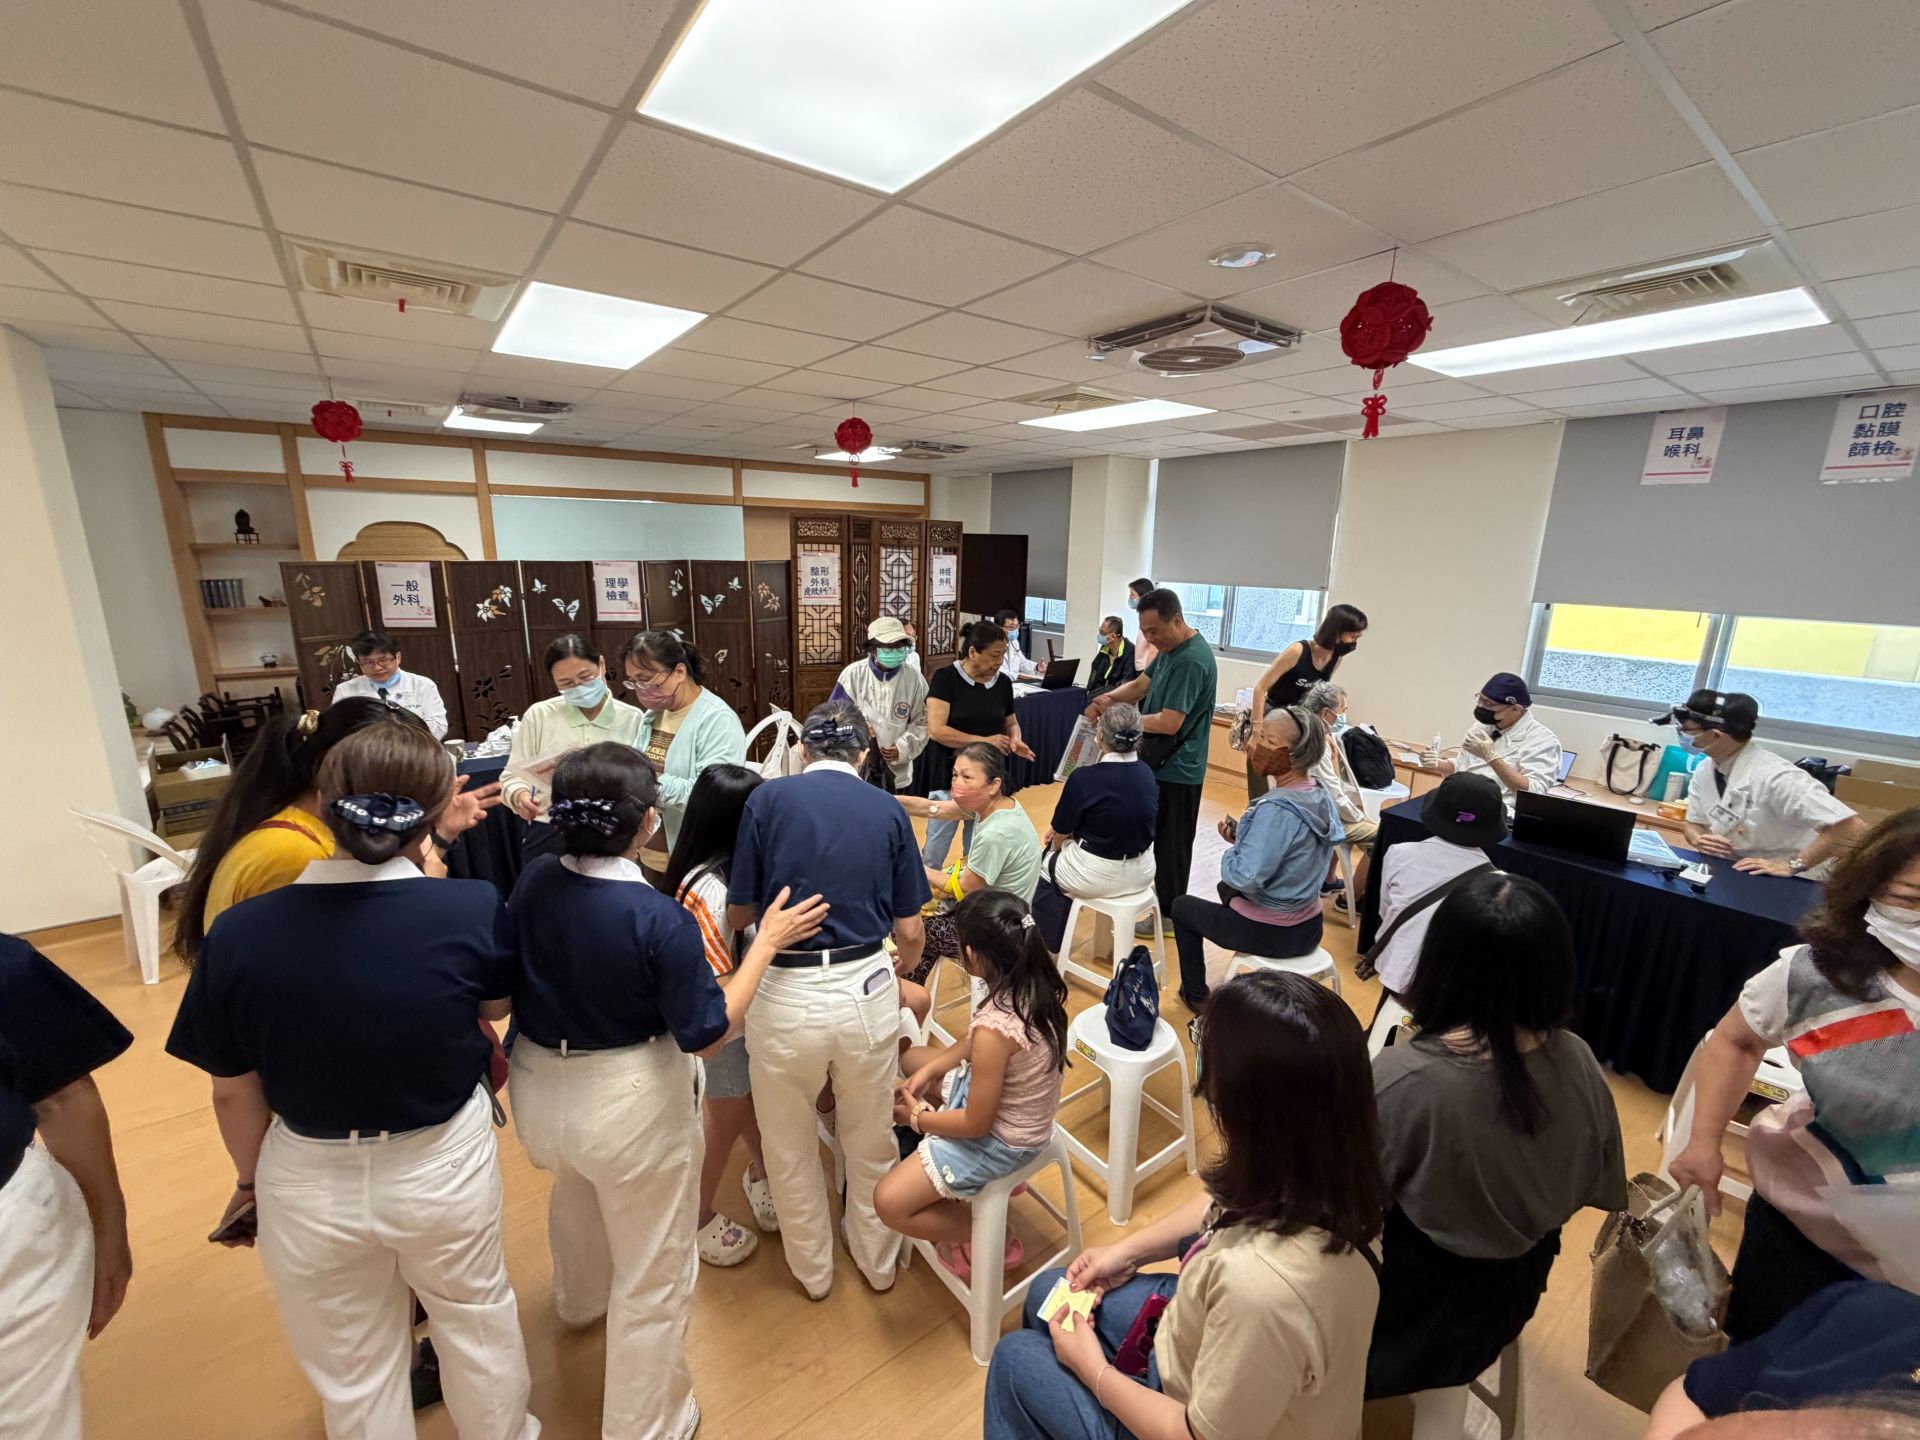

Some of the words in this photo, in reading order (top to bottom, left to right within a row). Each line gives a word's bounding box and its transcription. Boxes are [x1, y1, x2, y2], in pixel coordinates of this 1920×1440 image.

[1858, 402, 1907, 420] 口腔
[1666, 426, 1704, 441] 耳鼻
[1852, 421, 1901, 440] 黏膜
[1663, 443, 1701, 458] 喉科
[1847, 440, 1895, 458] 篩檢
[390, 579, 419, 592] 一般
[604, 577, 629, 589] 理學
[810, 577, 830, 588] 外科
[392, 593, 420, 606] 外科
[605, 589, 630, 601] 檢查
